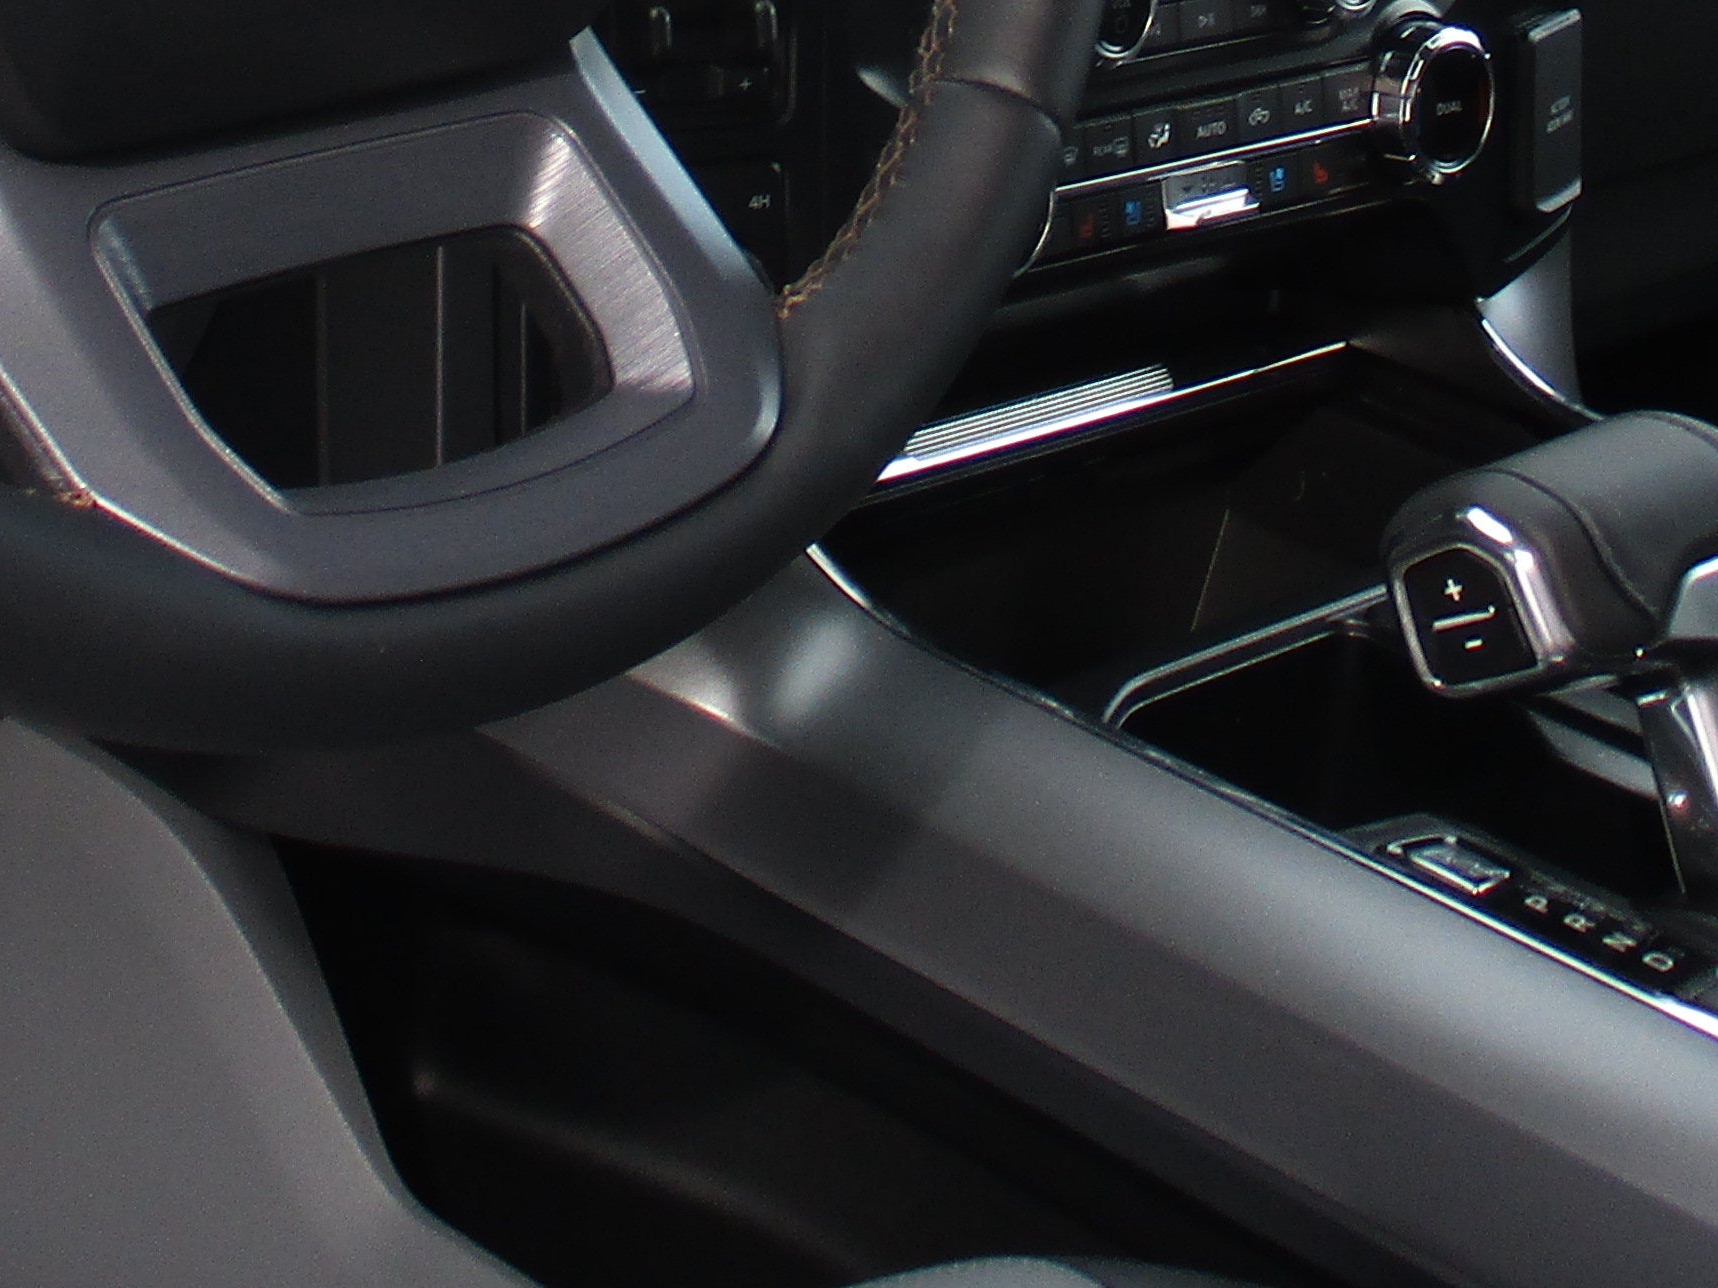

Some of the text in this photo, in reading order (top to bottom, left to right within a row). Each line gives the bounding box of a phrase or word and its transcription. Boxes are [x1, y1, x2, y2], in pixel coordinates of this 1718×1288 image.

[1294, 99, 1313, 116] A/C
[1436, 99, 1463, 116] DUAL
[1196, 121, 1227, 140] AUTO
[748, 193, 772, 210] 4H
